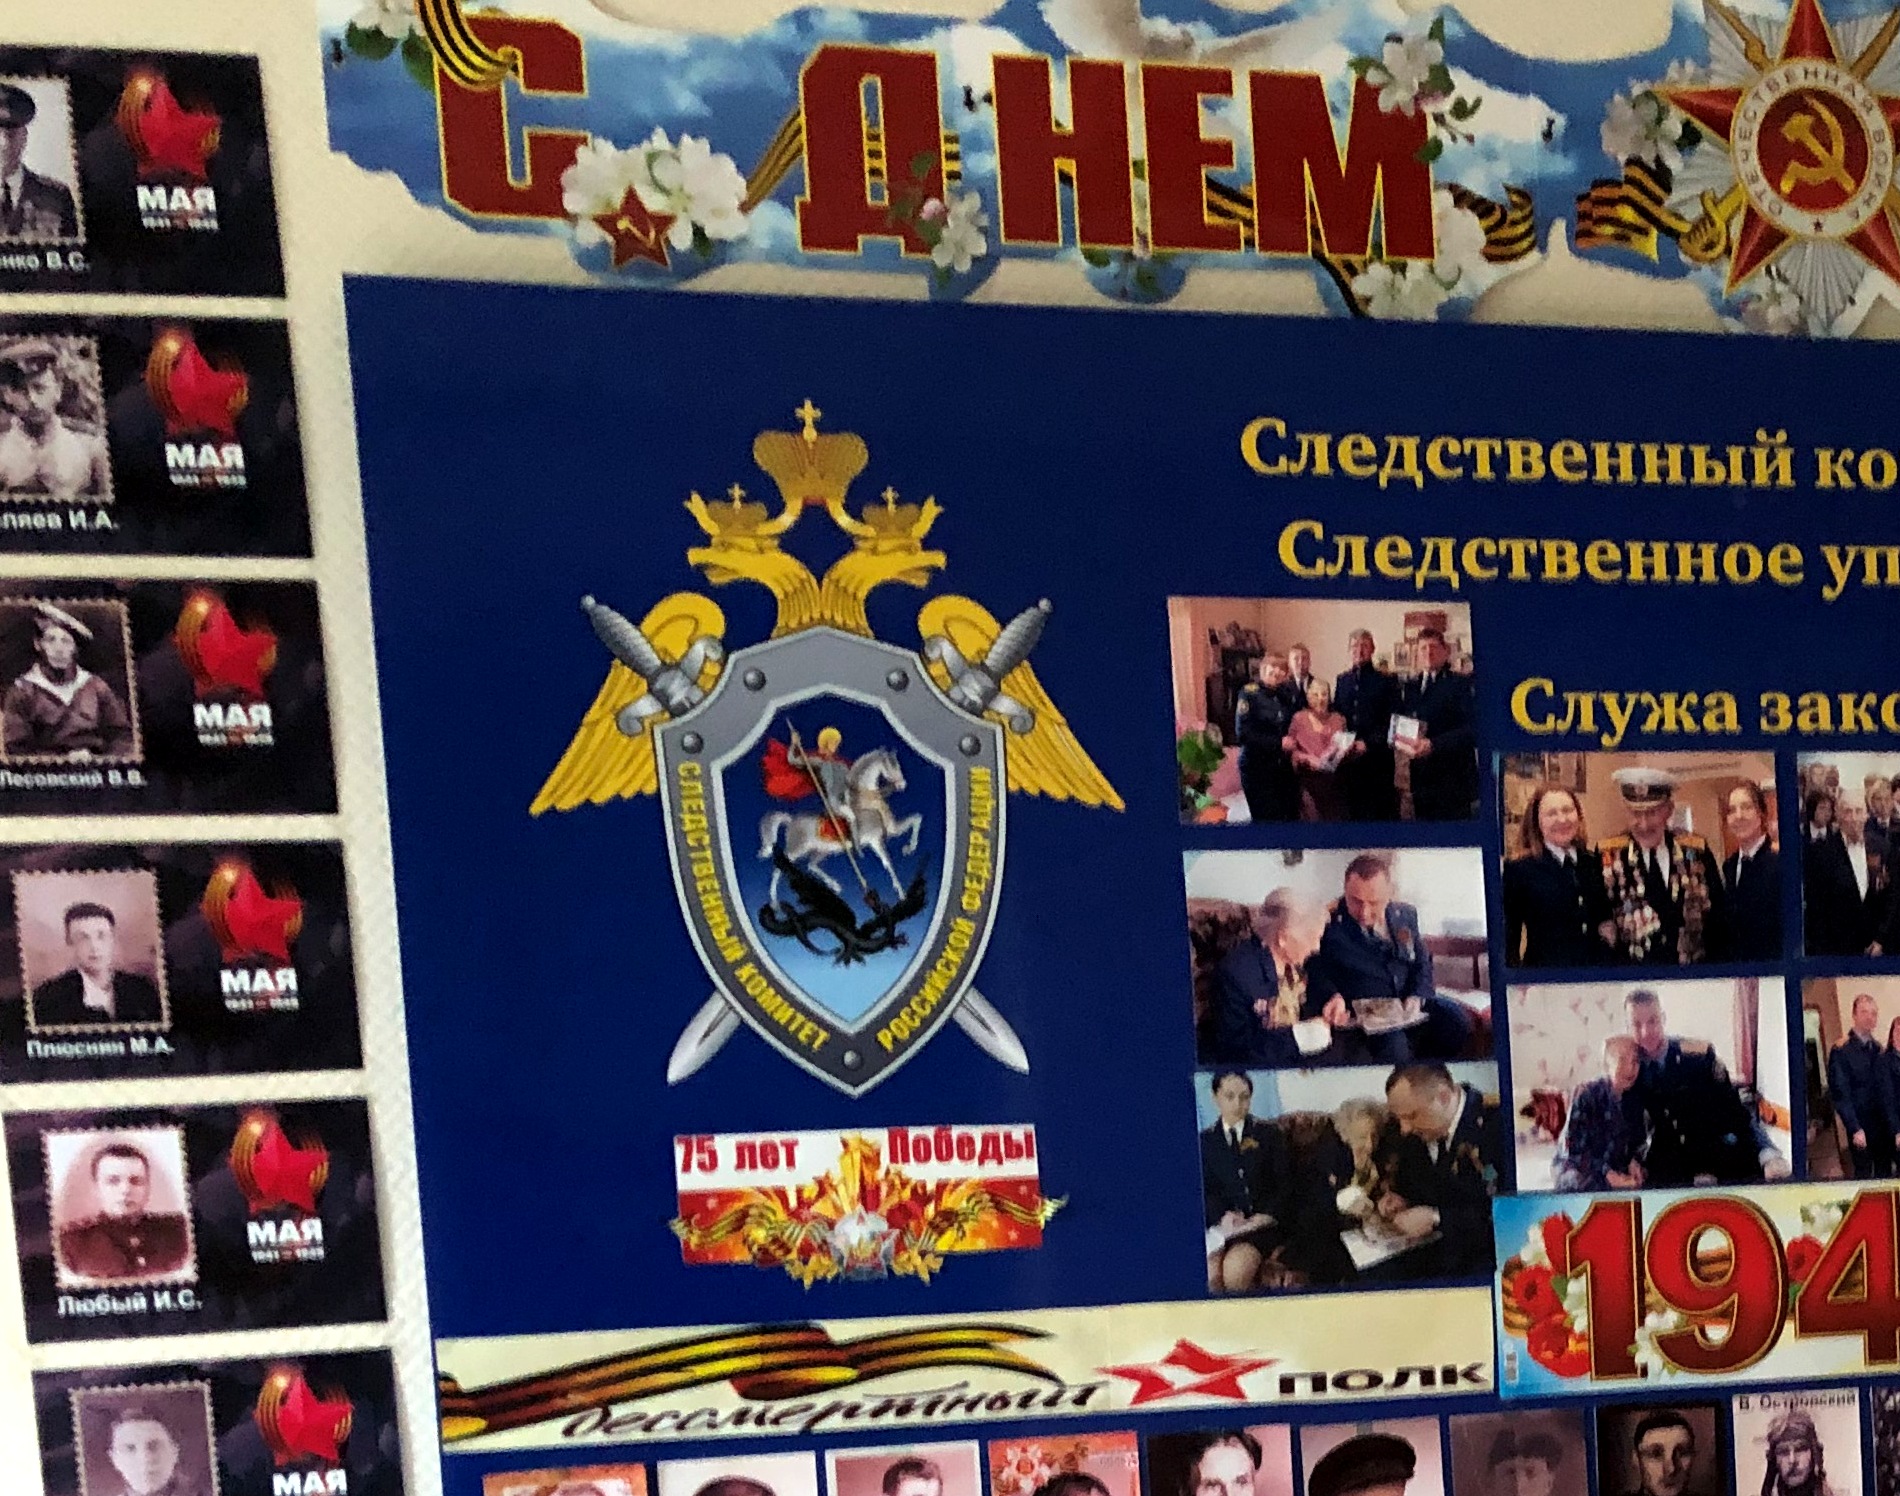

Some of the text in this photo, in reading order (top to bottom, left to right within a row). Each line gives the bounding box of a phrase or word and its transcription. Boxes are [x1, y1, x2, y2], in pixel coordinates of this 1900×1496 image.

[432, 14, 592, 220] С
[796, 43, 1436, 260] ДНЕМ
[136, 184, 216, 211] МАЯ
[164, 442, 245, 469] МАЯ
[1240, 416, 1797, 490] Следственный
[1278, 520, 1804, 590] Следственное
[193, 703, 273, 729] МАЯ
[1510, 677, 1741, 747] Служа
[678, 760, 997, 1052] СЛЕДСТВЕННЫЙ КОМИТЕТ РОССИЙСКОЙ ФЕДЕРАЦИИ
[220, 967, 299, 993] МАЯ
[677, 1126, 1036, 1174] 75 лет Победы
[246, 1217, 324, 1247] МАЯ
[57, 1292, 147, 1319] Любый
[273, 1468, 349, 1496] МАЯ
